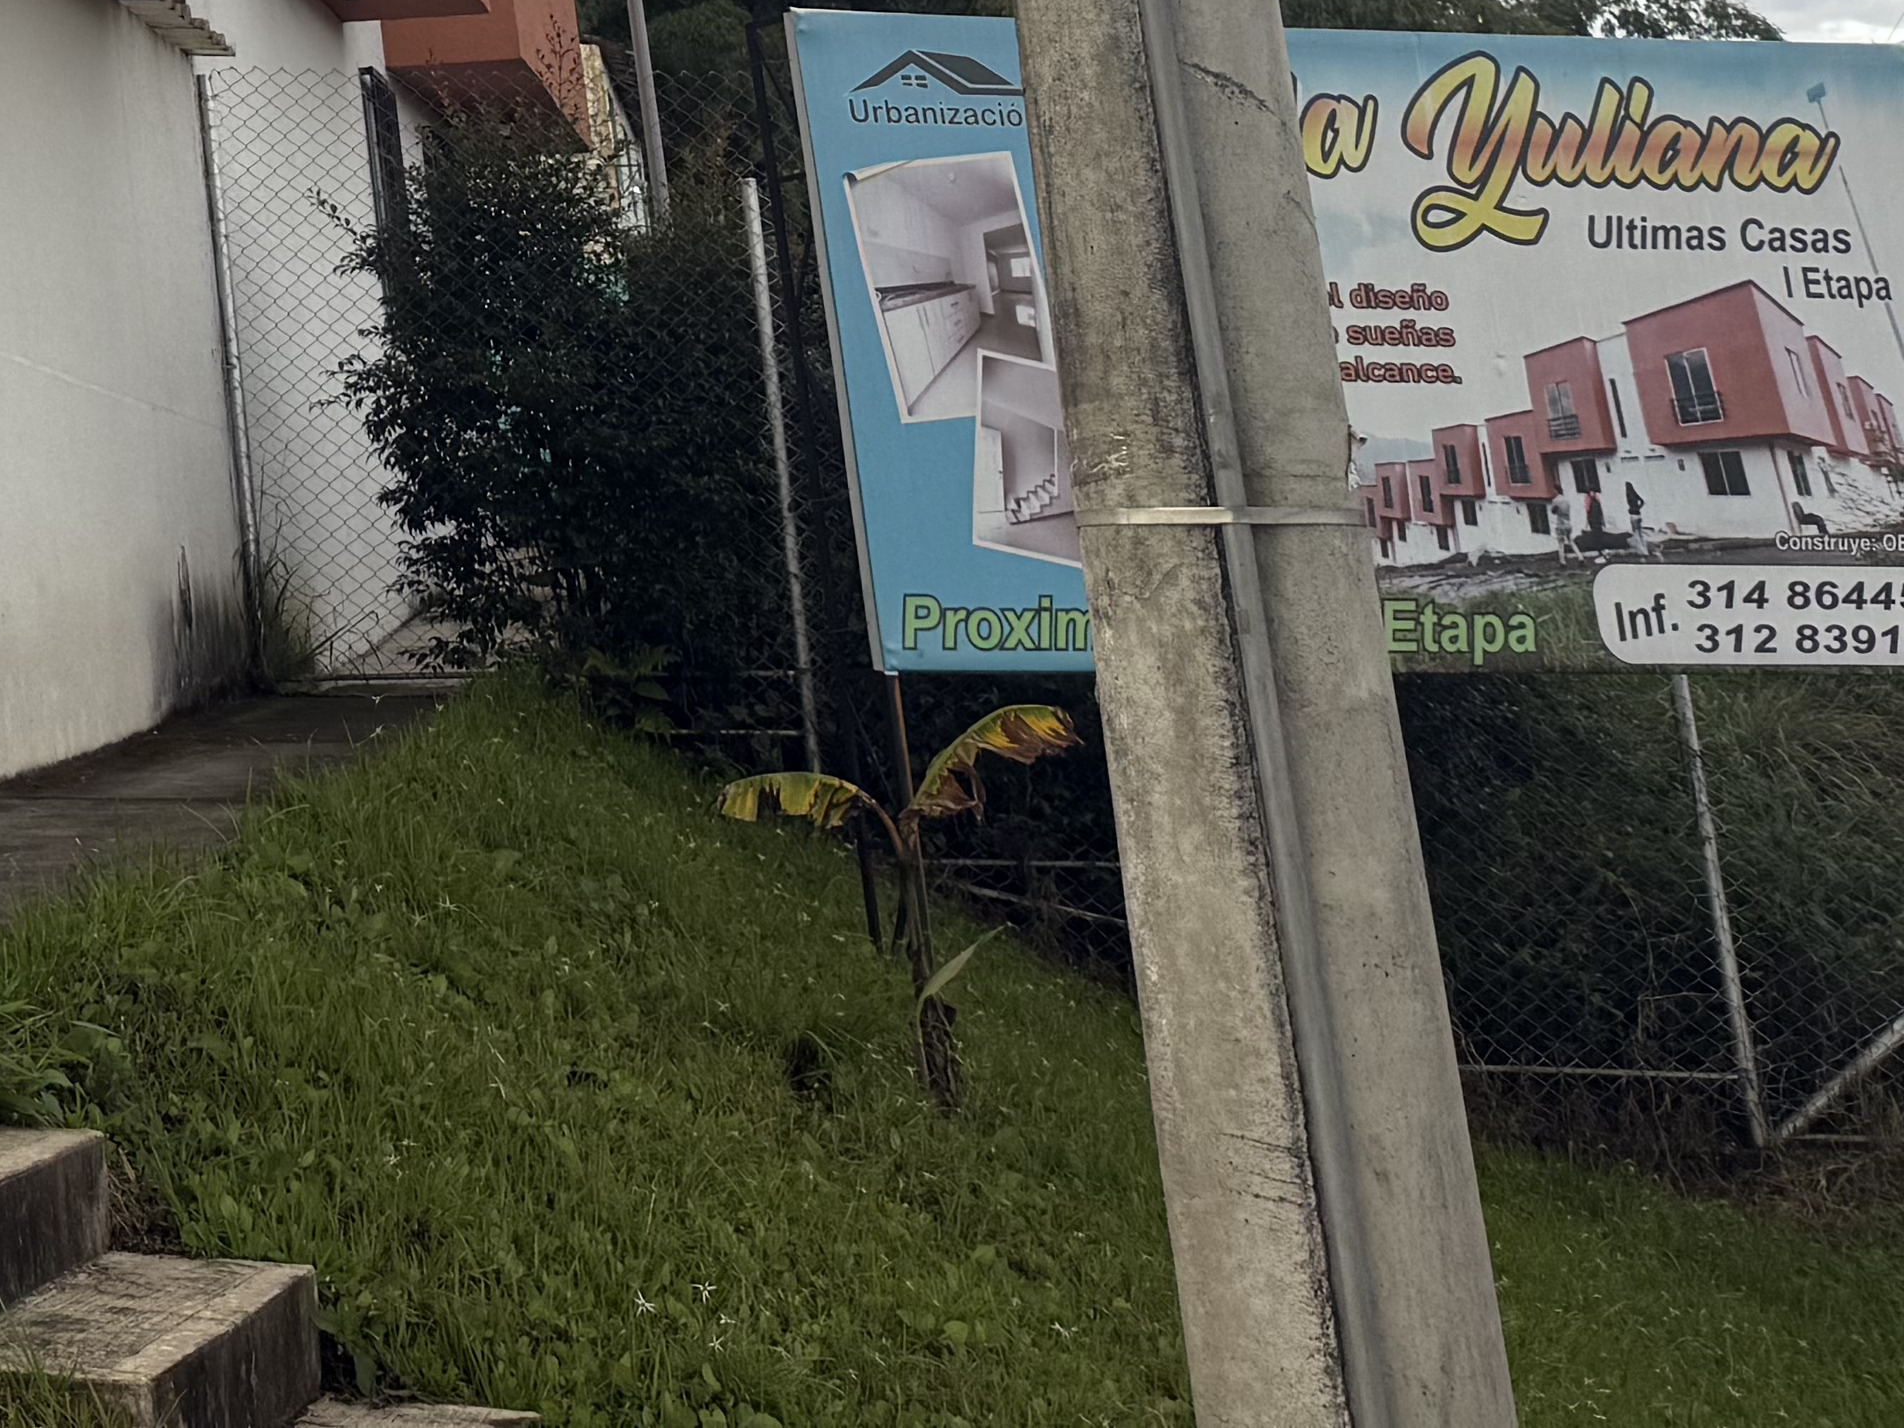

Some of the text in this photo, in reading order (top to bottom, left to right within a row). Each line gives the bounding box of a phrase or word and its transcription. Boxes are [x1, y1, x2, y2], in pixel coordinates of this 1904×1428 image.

[848, 98, 1024, 127] Urbanizació
[1290, 50, 1841, 252] a Yuliana
[1586, 215, 1853, 255] Ultimas Casas
[1349, 283, 1449, 311] diseño
[1803, 269, 1892, 308] Etapa
[1346, 319, 1456, 347] sueñas
[1339, 355, 1463, 385] alcance.
[1775, 530, 1876, 555] Construye:
[1614, 579, 1904, 642] Inf. 314 8644
[902, 593, 1538, 668] Proxim Etapa
[1694, 623, 1900, 654] 312 8391
